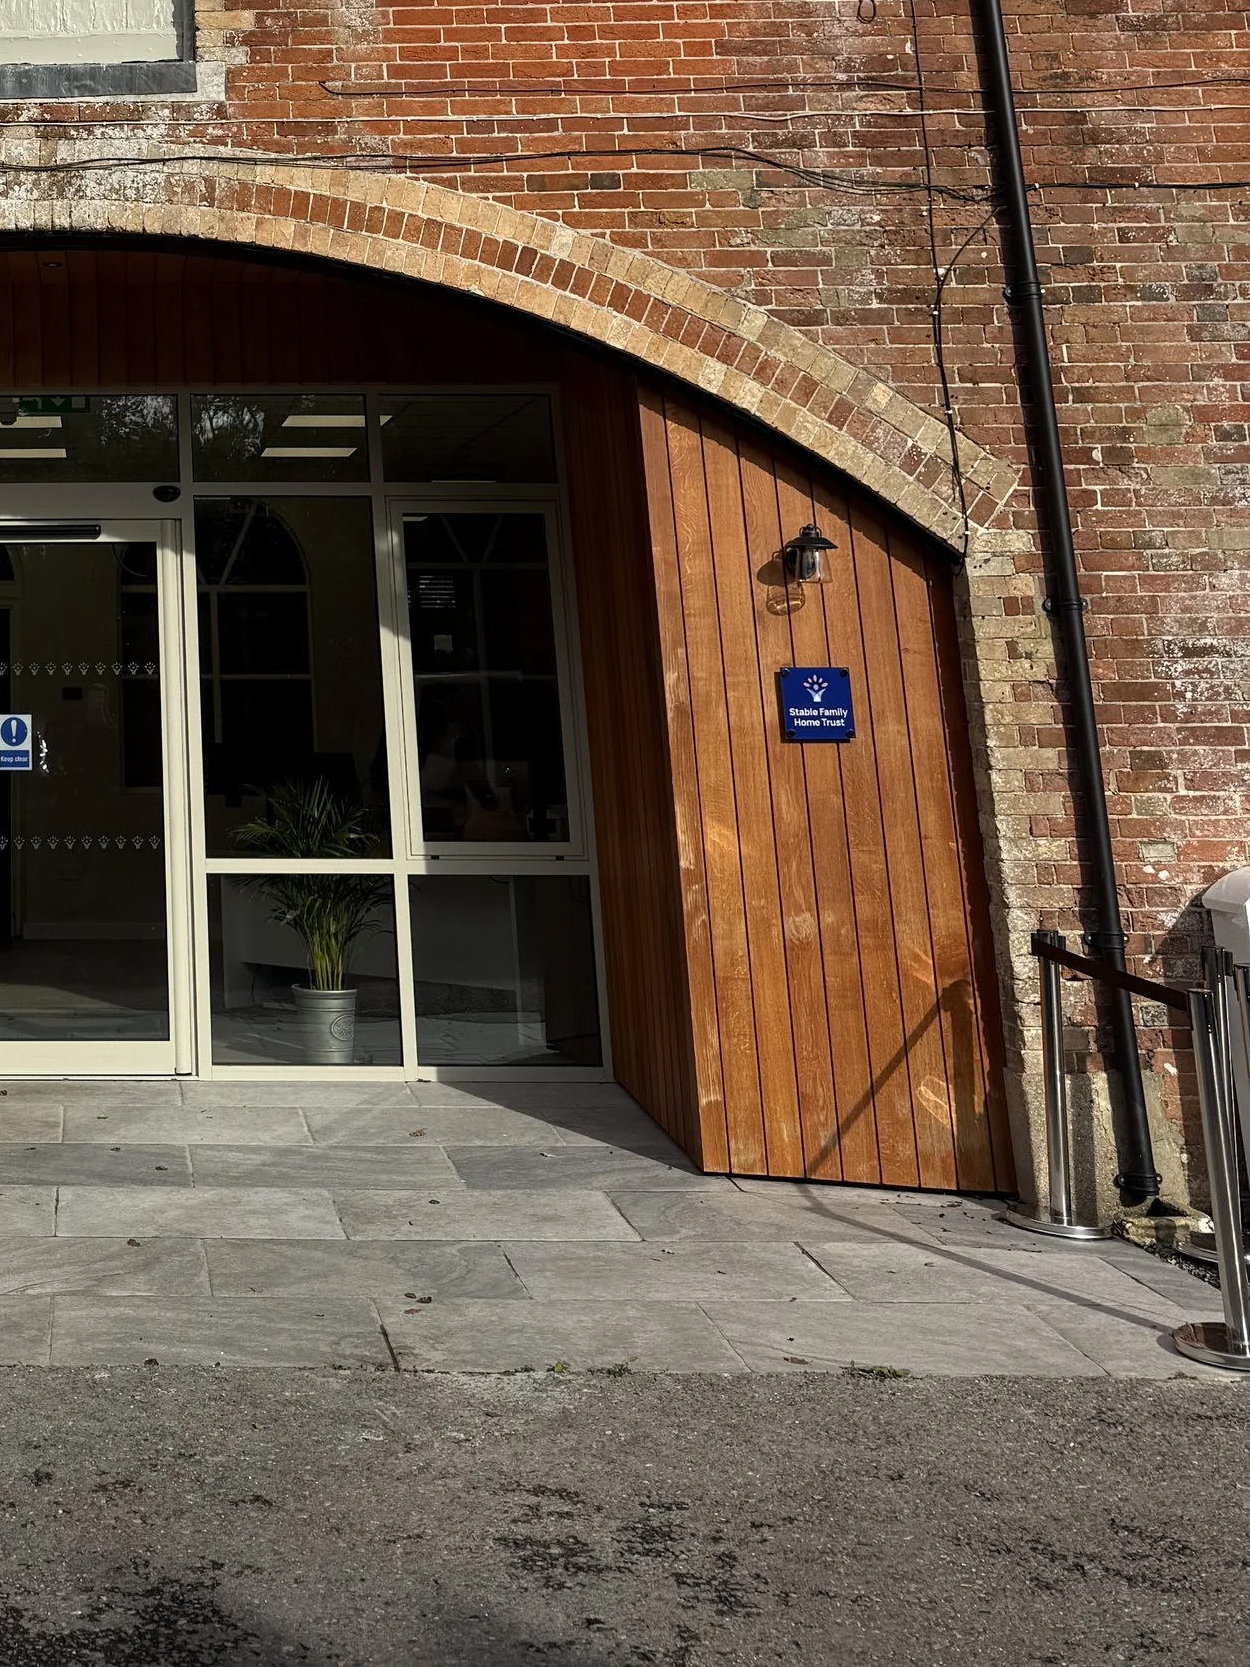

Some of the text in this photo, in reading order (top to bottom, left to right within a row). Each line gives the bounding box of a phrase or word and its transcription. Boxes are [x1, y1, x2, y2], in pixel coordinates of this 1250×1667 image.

[789, 708, 848, 718] Stable Family
[794, 718, 845, 727] Home Trust
